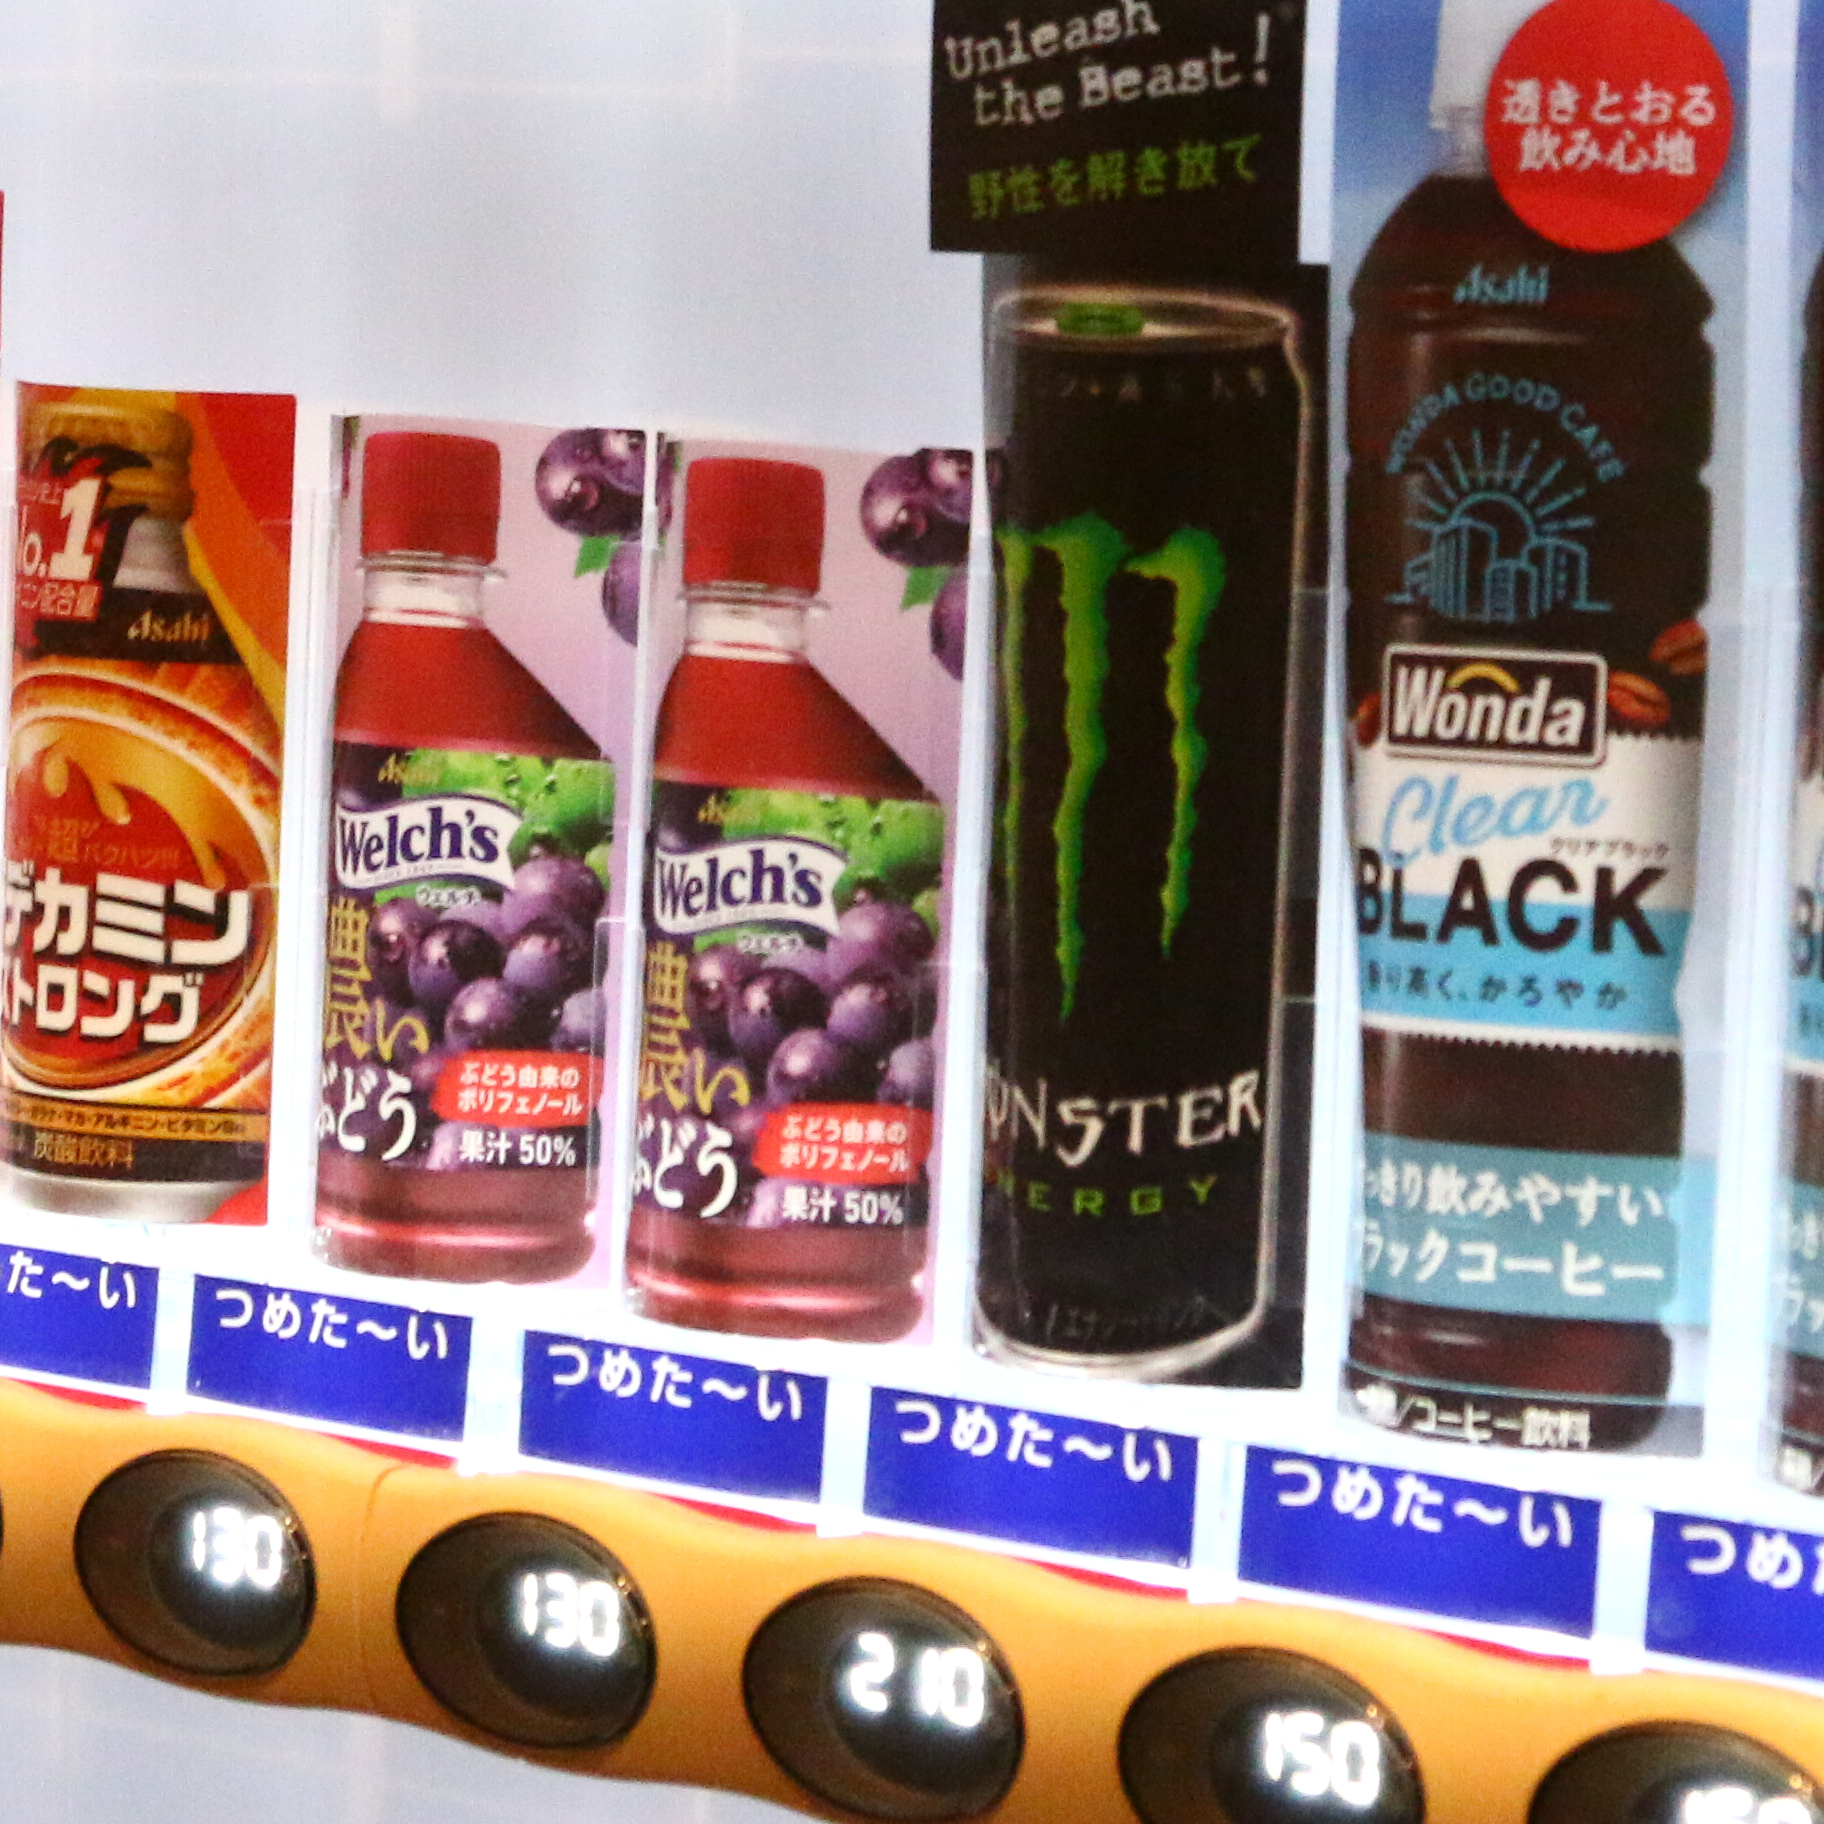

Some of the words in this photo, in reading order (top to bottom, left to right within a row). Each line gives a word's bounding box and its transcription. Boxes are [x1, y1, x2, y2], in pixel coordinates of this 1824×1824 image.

[974, 77, 1064, 127] the
[1500, 78, 1716, 127] 透きとおる
[1518, 127, 1697, 176] 飲み心地
[1464, 372, 1561, 412] GOOD
[1393, 664, 1585, 747] Wonda
[339, 805, 500, 871] Welch's
[1380, 775, 1610, 868] Clear
[1357, 846, 1670, 956] BLACK
[458, 1090, 583, 1117] ポリフェノール
[459, 1062, 580, 1090] ぶどう由来の
[780, 1144, 909, 1173] ポリフェノール
[781, 1116, 906, 1146] ぶどう由来の
[191, 1507, 284, 1588] 130
[518, 1572, 622, 1657] 130
[849, 1631, 986, 1728] 210
[1263, 1710, 1379, 1808] 150
